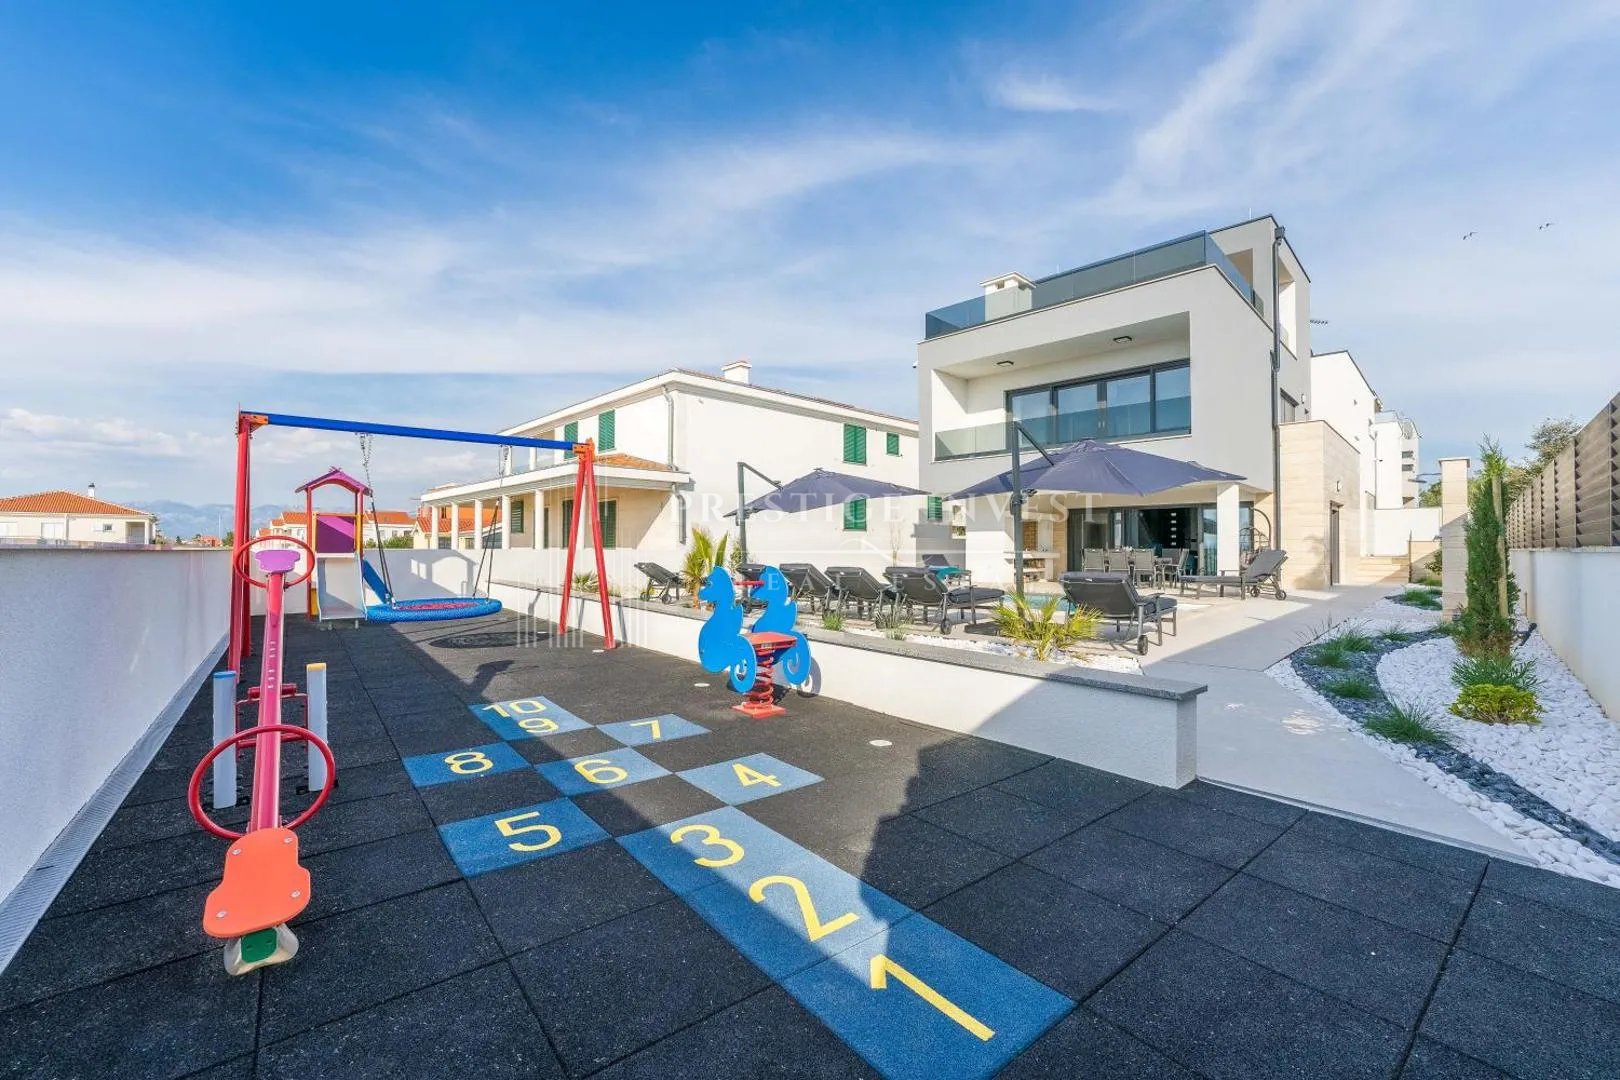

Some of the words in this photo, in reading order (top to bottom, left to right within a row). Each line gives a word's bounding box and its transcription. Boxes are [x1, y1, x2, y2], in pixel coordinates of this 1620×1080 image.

[482, 700, 547, 718] 10
[518, 718, 559, 733] 9
[630, 719, 661, 740] 7
[444, 751, 494, 774] 8
[574, 759, 629, 784] 6
[732, 763, 782, 787] 4
[494, 811, 562, 852] 5
[670, 824, 744, 867] 3
[749, 875, 860, 942] 2
[870, 953, 996, 1042] 1
